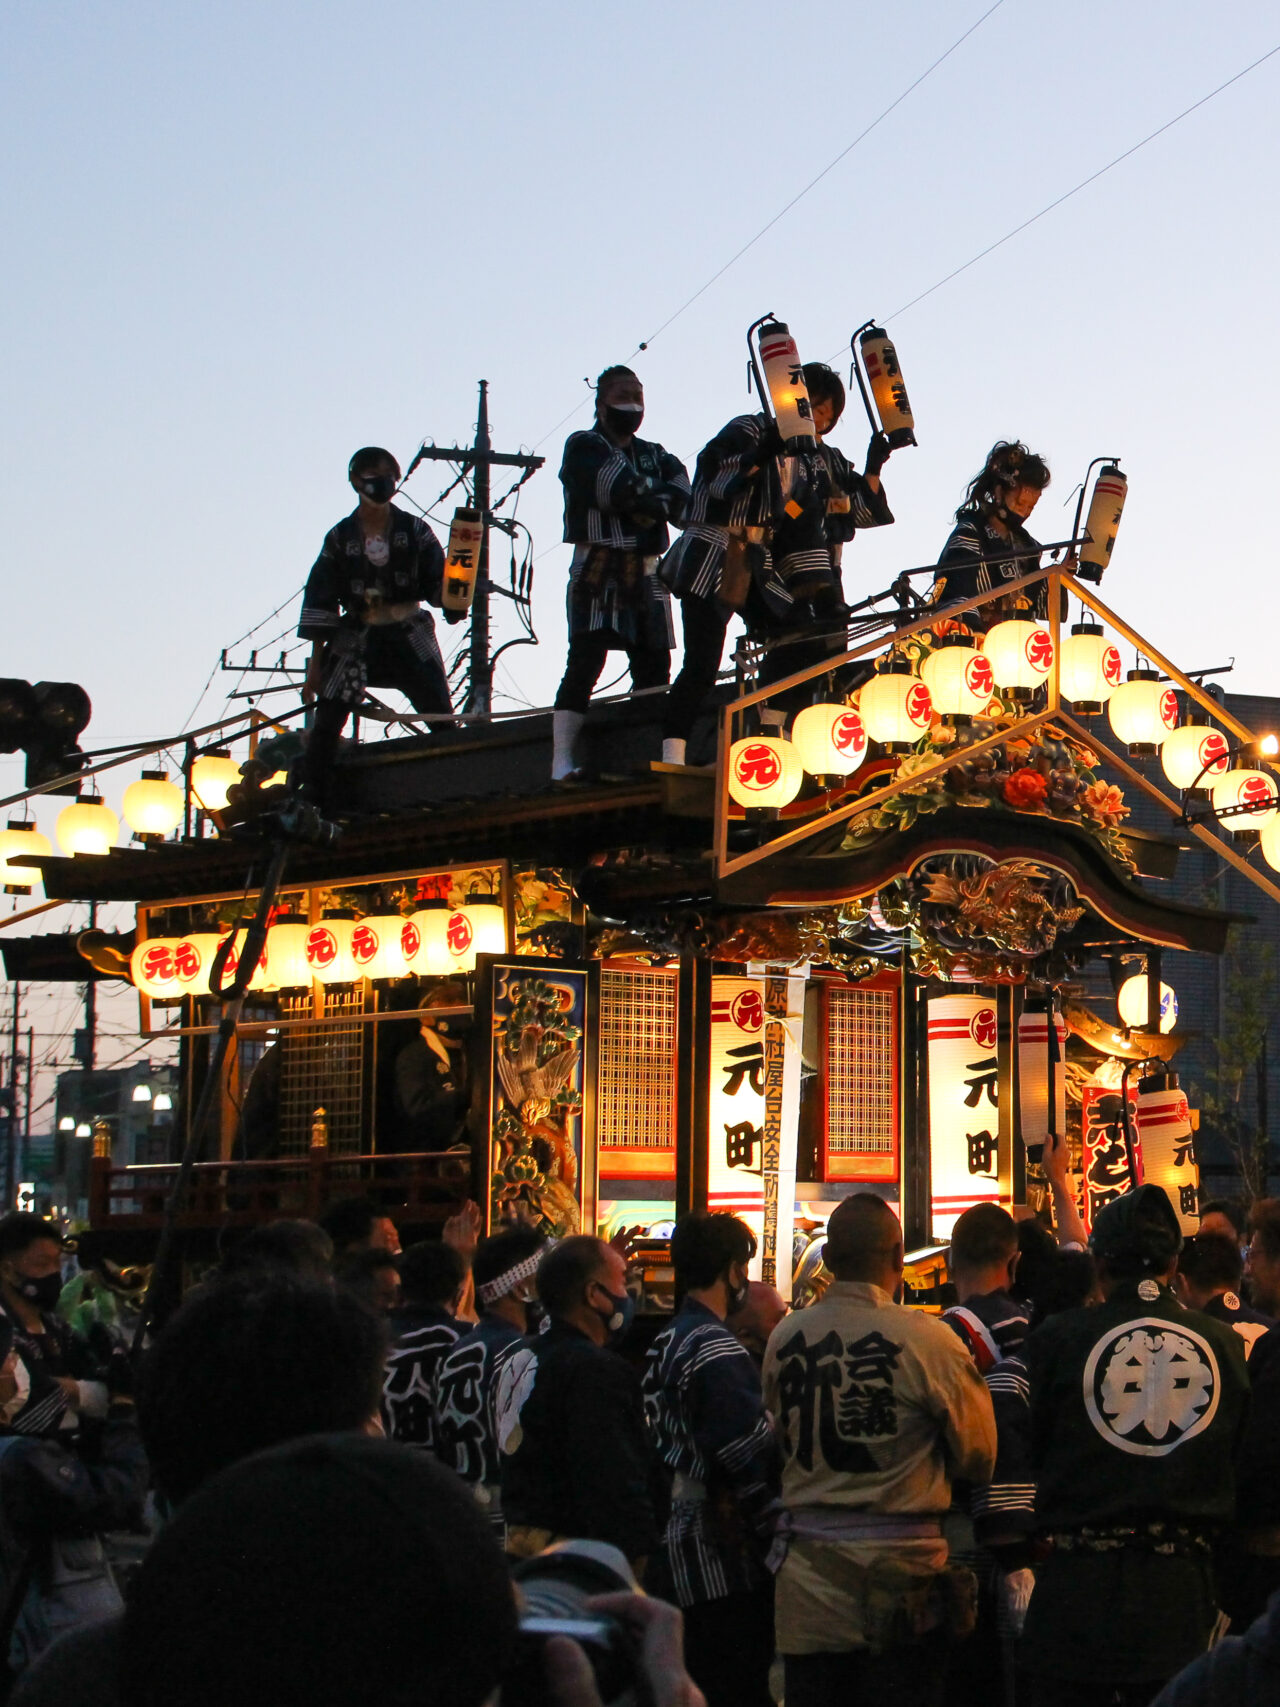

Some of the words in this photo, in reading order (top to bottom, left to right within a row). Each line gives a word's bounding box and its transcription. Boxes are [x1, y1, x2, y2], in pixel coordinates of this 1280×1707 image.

[1030, 631, 1053, 668] 元
[971, 656, 993, 693] 元
[911, 684, 932, 722] 元
[837, 713, 865, 752] 元
[739, 744, 780, 785] 元
[307, 928, 335, 963] 元
[352, 926, 377, 958] 元
[447, 913, 471, 949] 元
[145, 946, 174, 980] 元
[174, 942, 199, 976] 元
[737, 991, 763, 1028] 元
[722, 1041, 765, 1177] 元町
